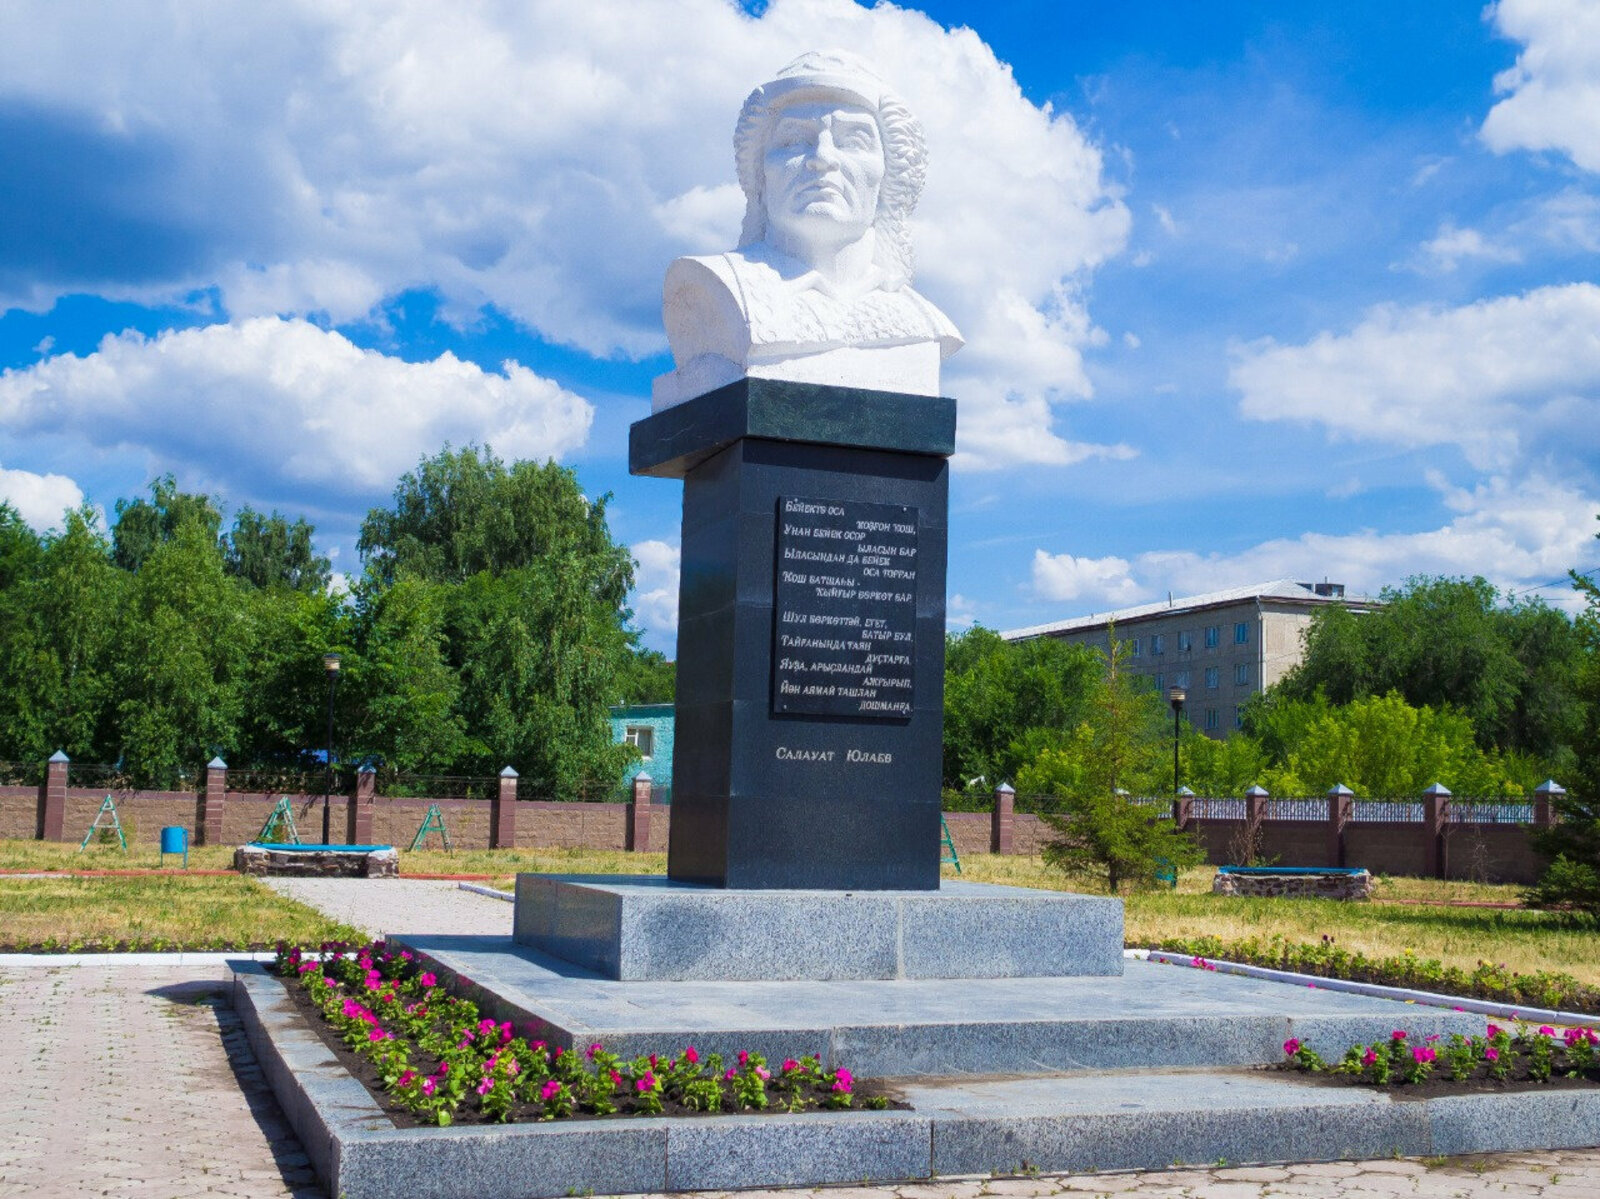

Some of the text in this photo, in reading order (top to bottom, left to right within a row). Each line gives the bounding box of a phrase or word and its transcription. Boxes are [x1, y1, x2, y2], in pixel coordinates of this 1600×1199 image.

[828, 506, 845, 516] ОСА
[783, 523, 811, 537] УНАН
[846, 554, 859, 566] ДА
[863, 567, 880, 577] ОСА
[782, 610, 807, 624] ШУЛ
[861, 629, 892, 641] БАТЫР
[802, 685, 836, 696] АЯМАЙ
[837, 687, 877, 697] ТАШЛАН
